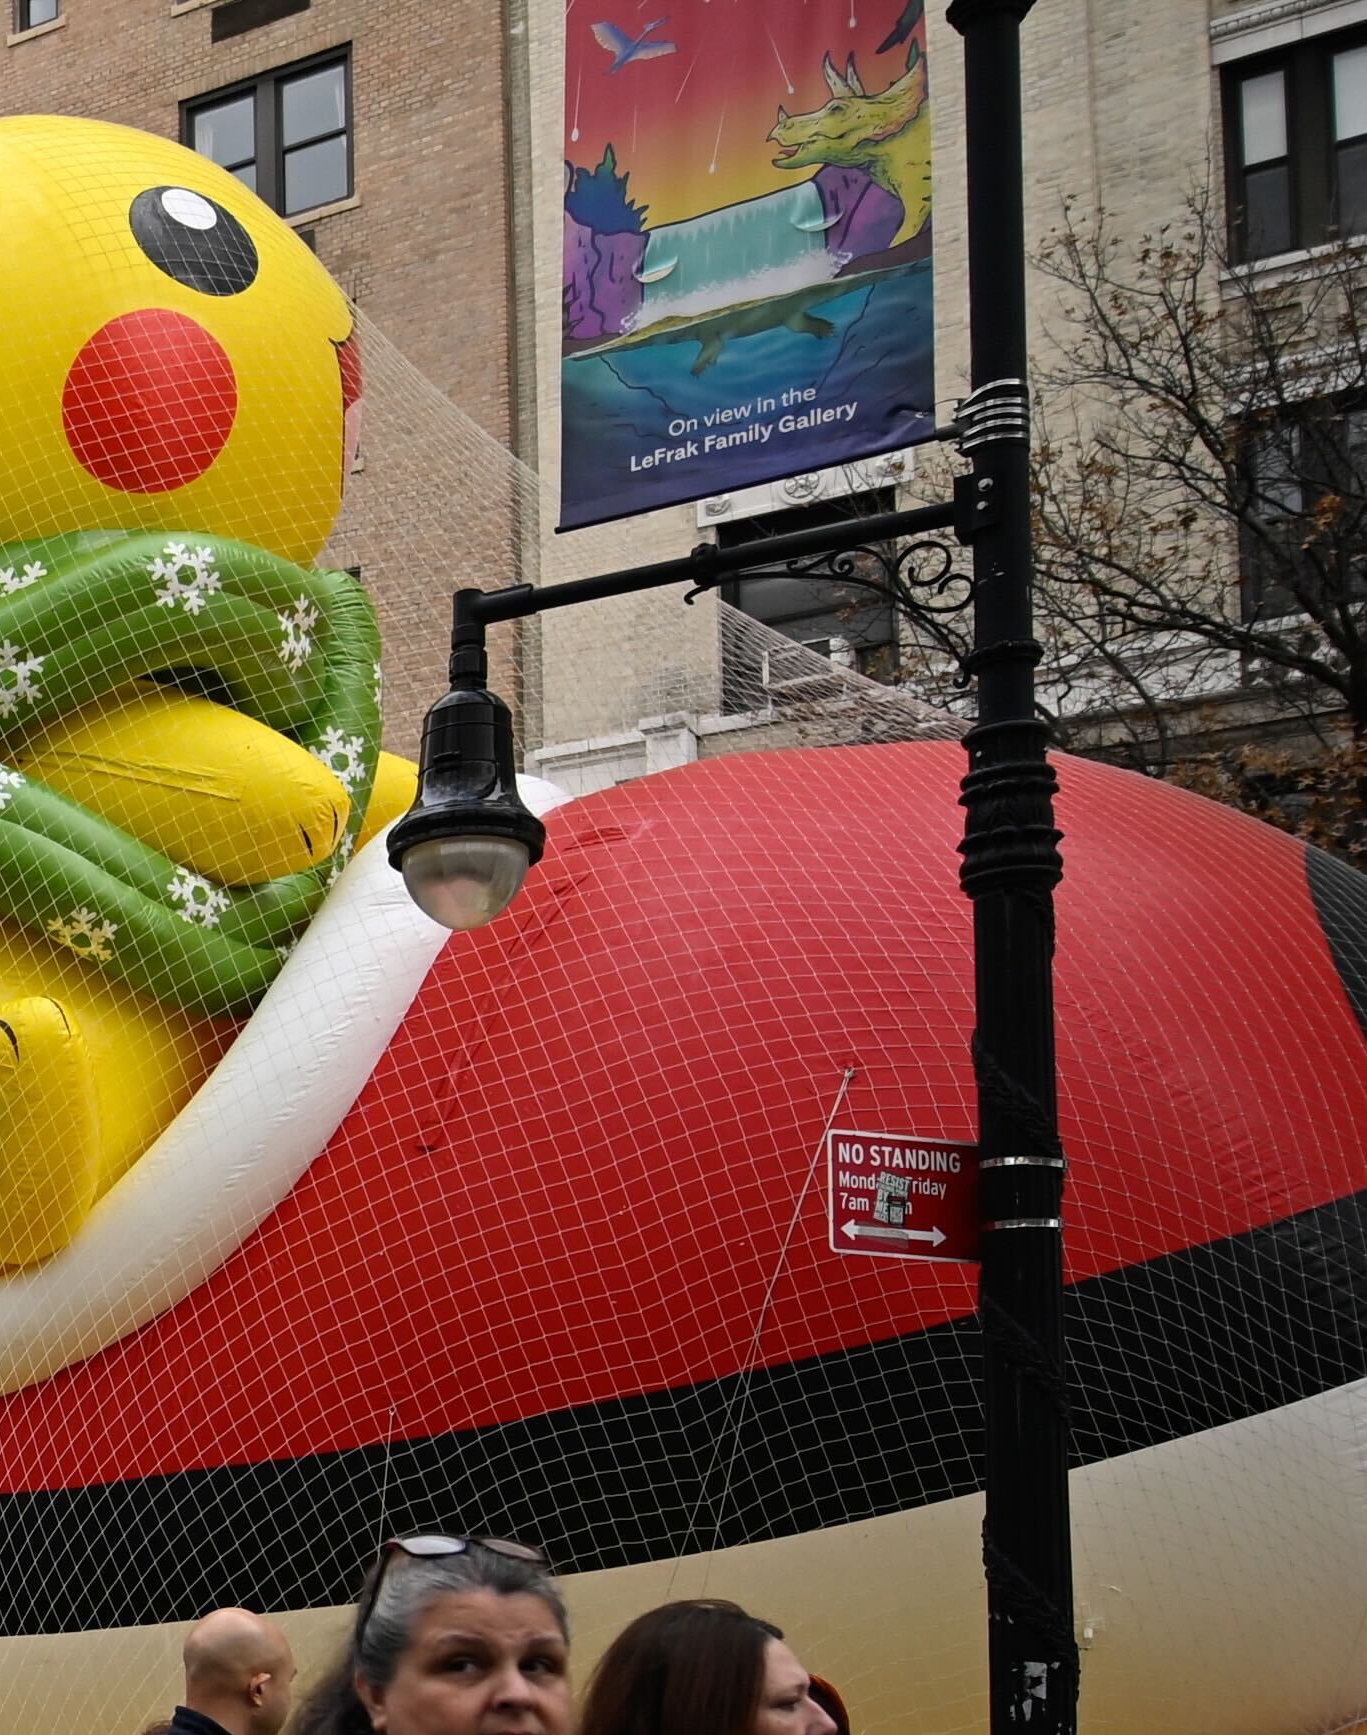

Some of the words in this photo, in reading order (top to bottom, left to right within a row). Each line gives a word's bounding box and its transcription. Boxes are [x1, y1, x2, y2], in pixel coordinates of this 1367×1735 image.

[668, 418, 698, 437] On
[703, 403, 752, 427] view
[756, 397, 776, 414] in
[780, 387, 817, 408] the
[630, 441, 699, 472] LeFrak
[704, 422, 774, 454] Family
[778, 401, 858, 433] Gallery
[838, 1142, 864, 1164] NO
[869, 1145, 961, 1173] STANDING
[879, 1170, 911, 1192] RESIST
[839, 1192, 870, 1212] 7am
